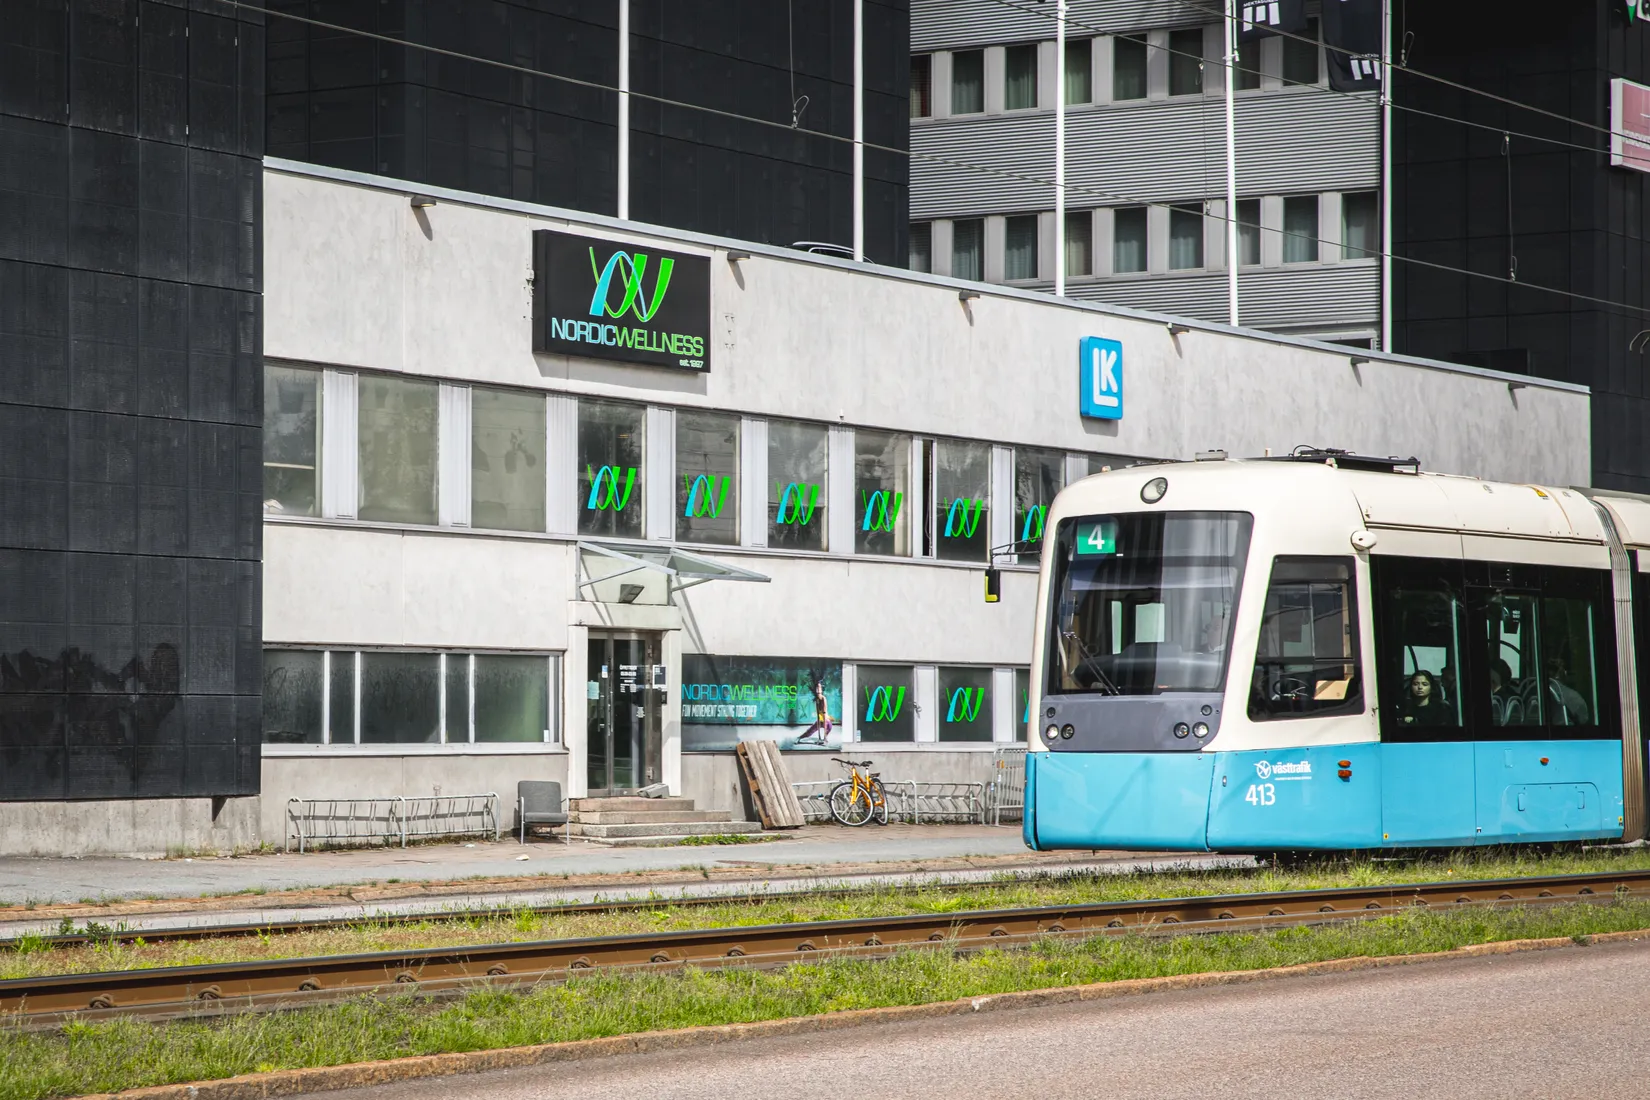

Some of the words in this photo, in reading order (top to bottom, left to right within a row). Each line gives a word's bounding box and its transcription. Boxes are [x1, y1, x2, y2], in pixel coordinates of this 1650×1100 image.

[551, 317, 704, 358] NORDICWELLNESS
[1093, 347, 1119, 407] LK
[1088, 524, 1105, 550] 4
[682, 683, 797, 701] NORDICWELLNESS
[1272, 760, 1312, 775] västtrafik
[1245, 783, 1276, 806] 413
